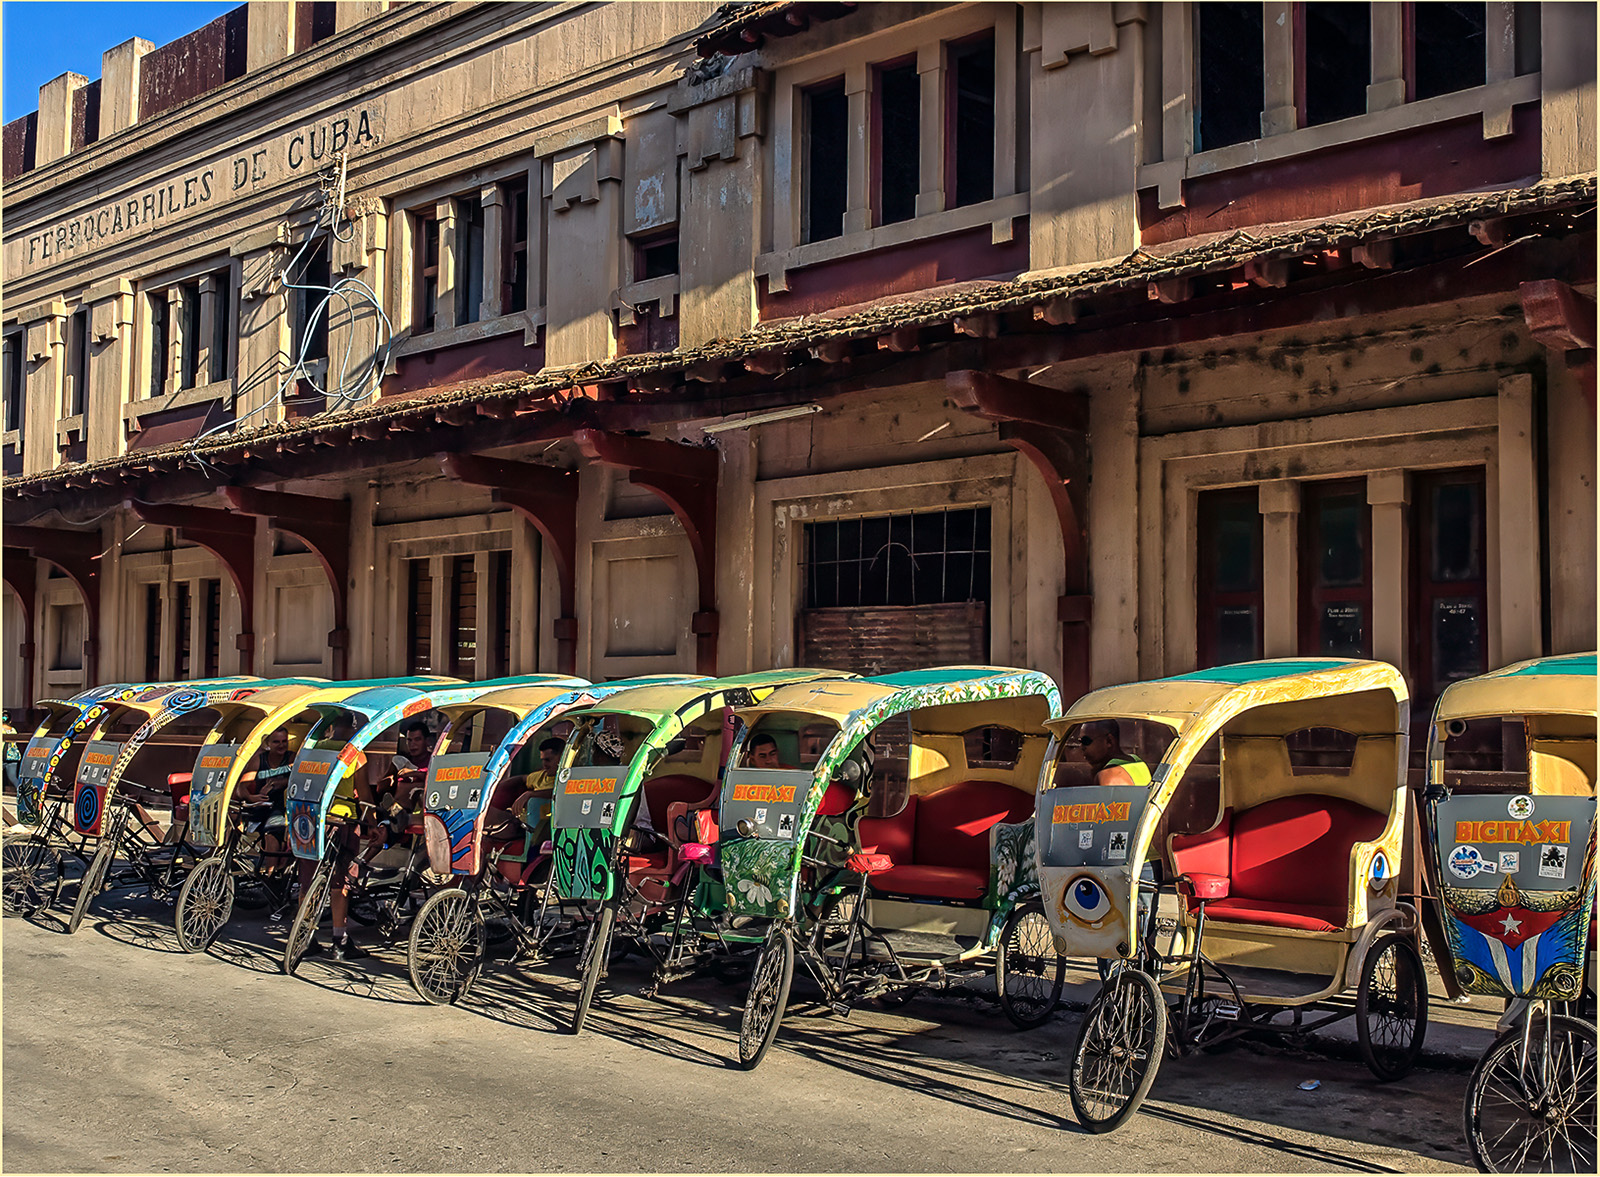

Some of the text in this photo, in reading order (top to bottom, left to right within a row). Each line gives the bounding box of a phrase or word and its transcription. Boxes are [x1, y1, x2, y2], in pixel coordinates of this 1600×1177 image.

[28, 169, 214, 265] FERROCARRILES
[232, 149, 267, 192] DE
[435, 765, 483, 782] BICITAXI
[564, 778, 617, 795] BICITAXI
[732, 784, 797, 804] BICITAXI
[1052, 801, 1132, 825] BICITAXI
[1454, 819, 1571, 846] BICITAXI
